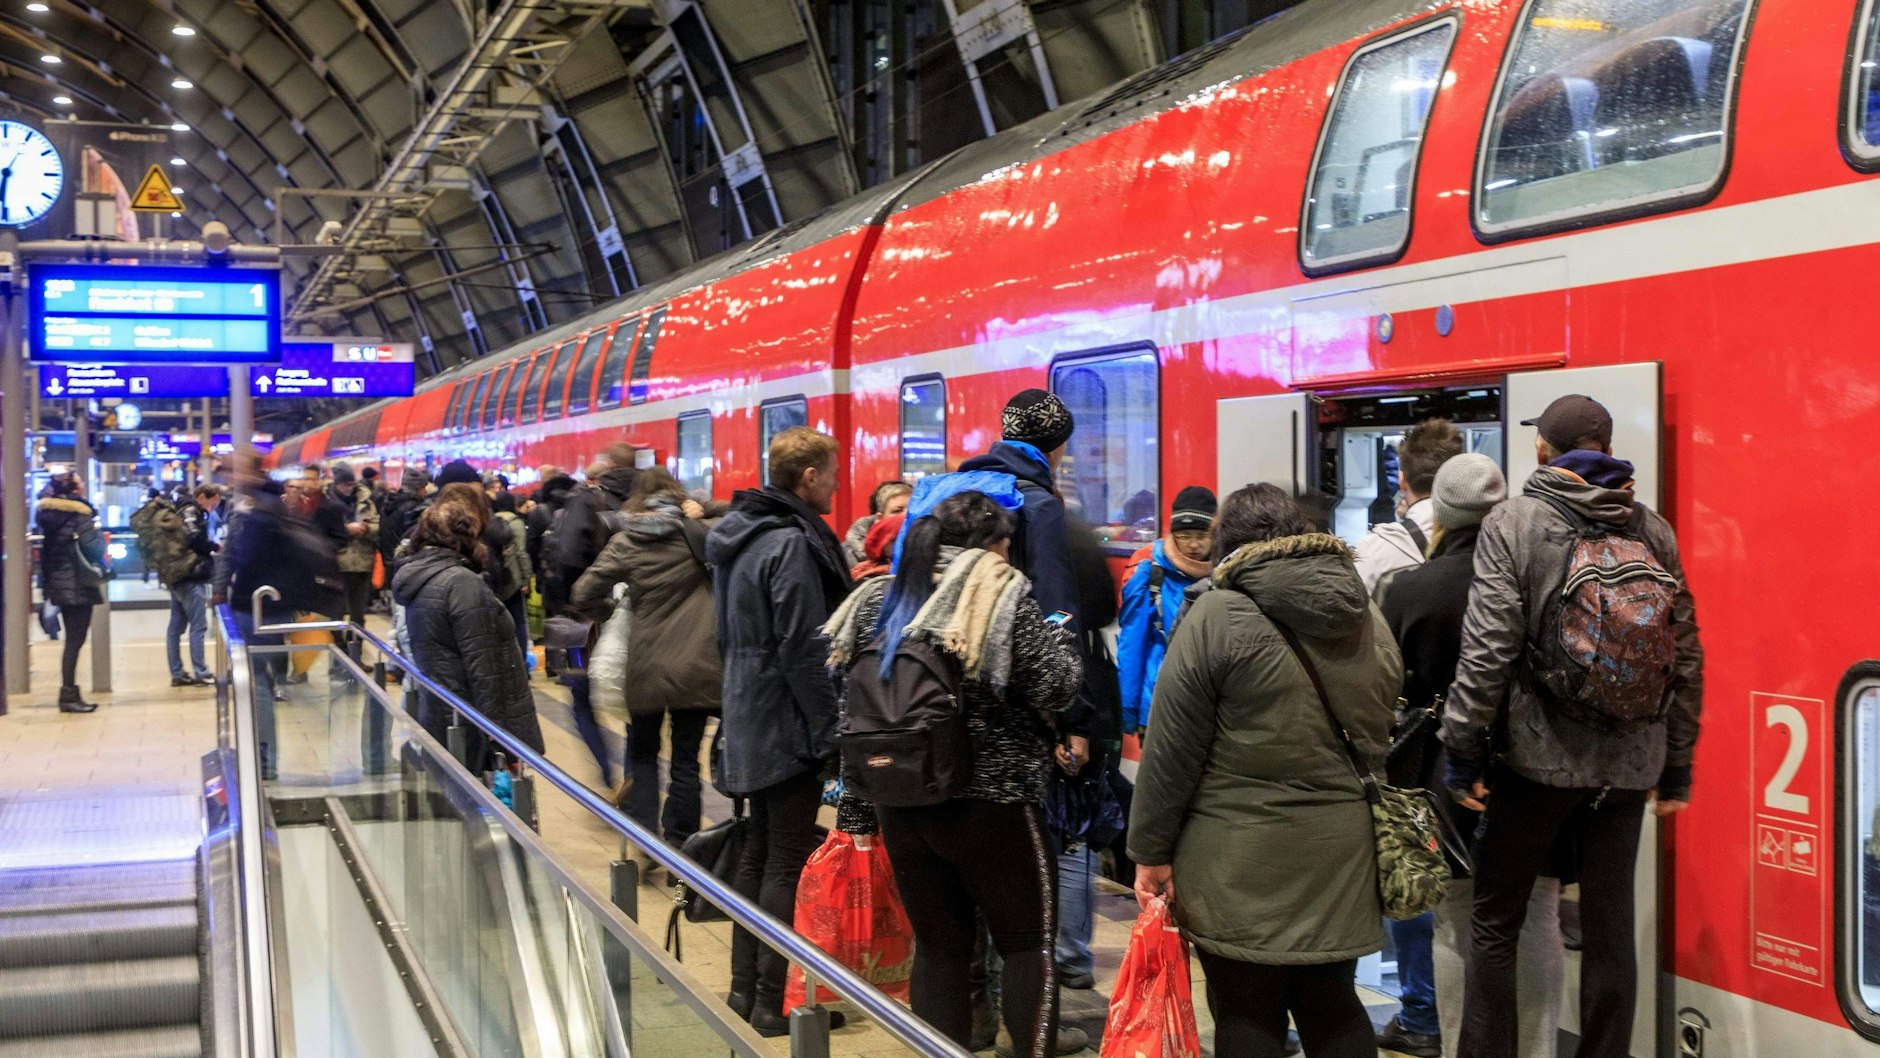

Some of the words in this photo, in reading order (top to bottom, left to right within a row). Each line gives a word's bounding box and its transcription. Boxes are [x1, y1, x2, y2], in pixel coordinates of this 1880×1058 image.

[250, 284, 263, 307] 1
[348, 346, 362, 361] S
[363, 347, 377, 361] U
[1764, 703, 1810, 815] 2
